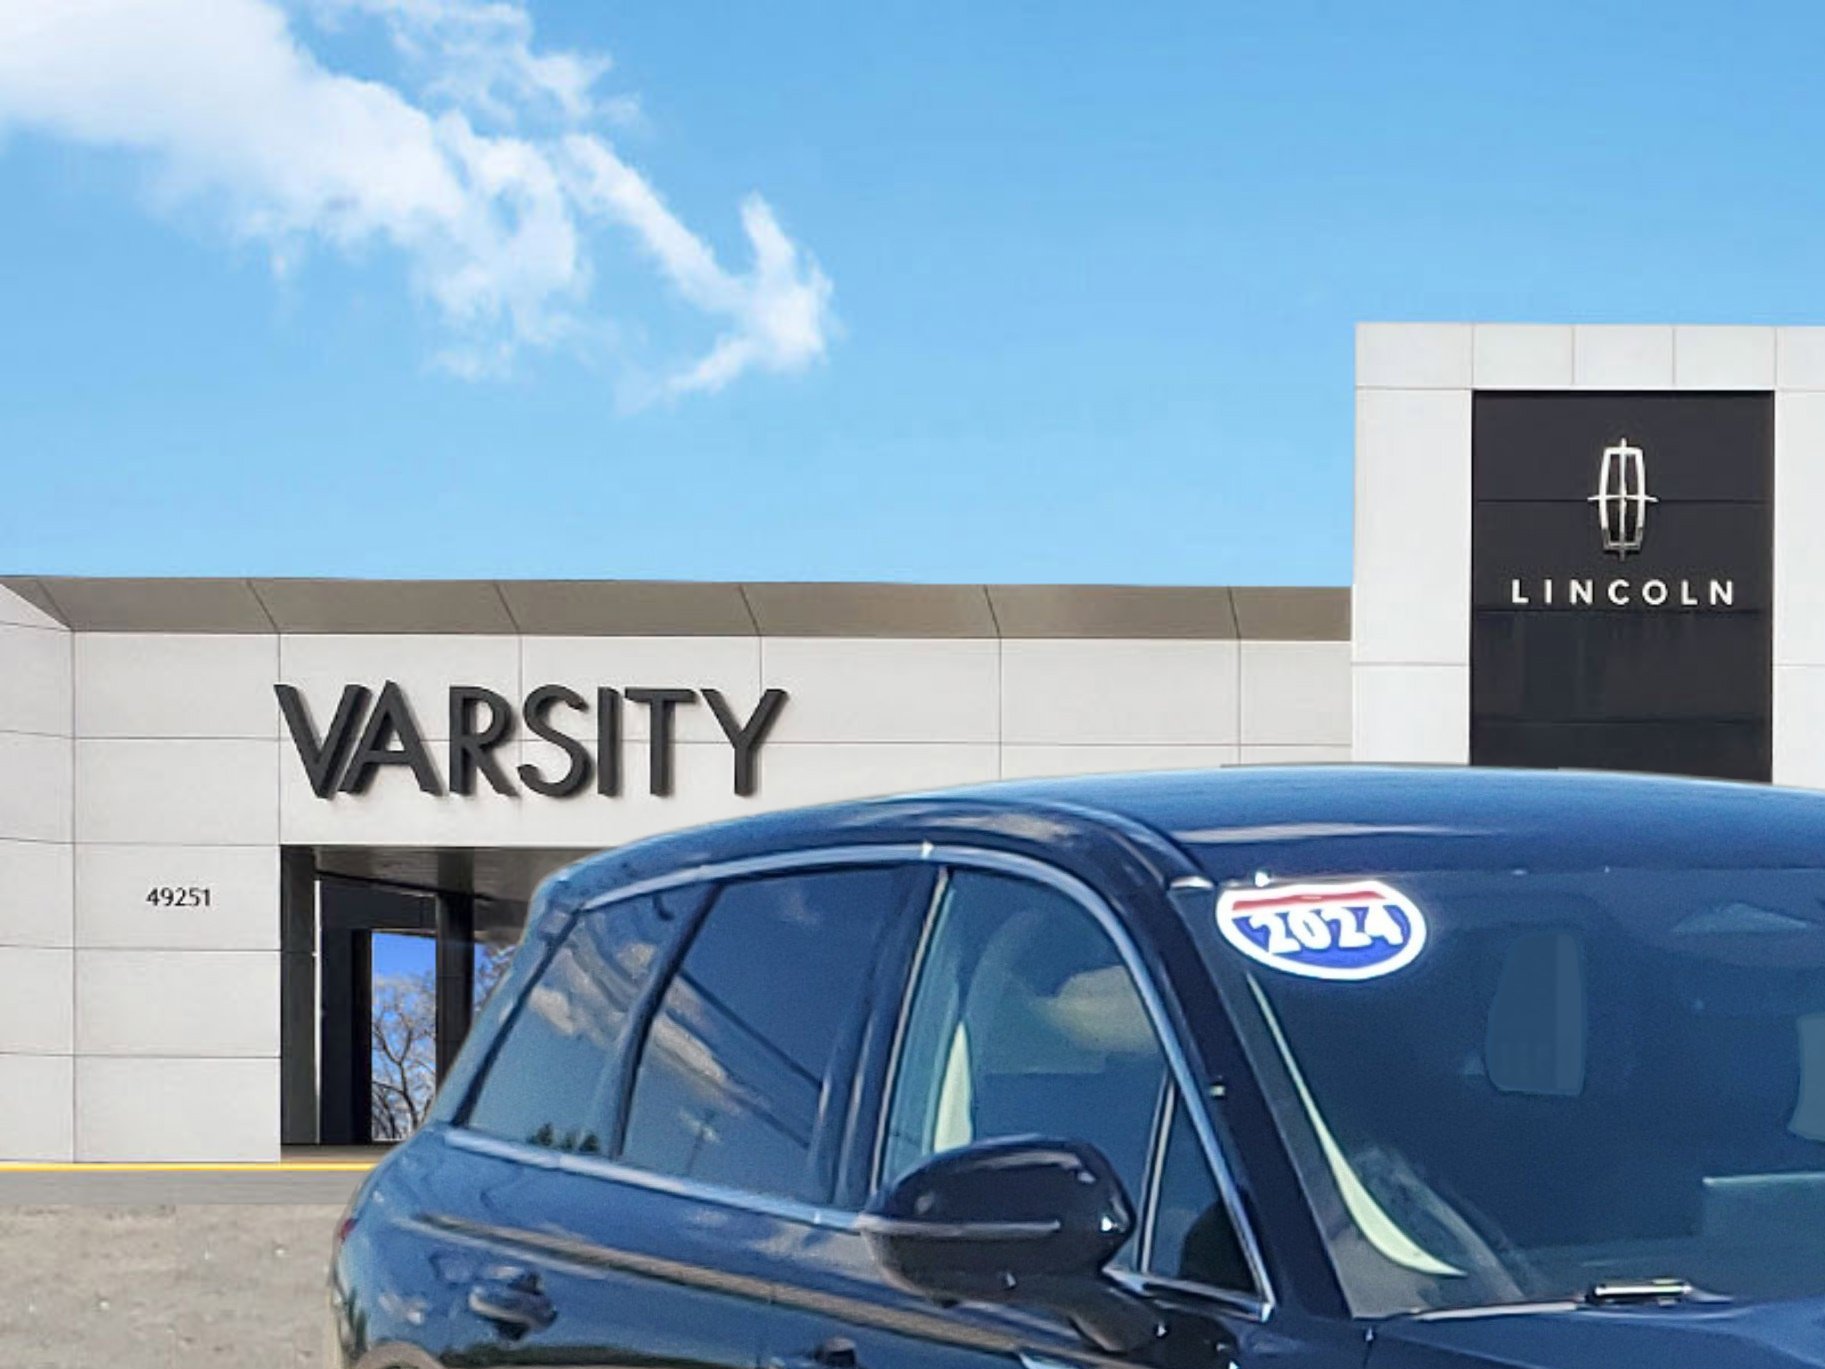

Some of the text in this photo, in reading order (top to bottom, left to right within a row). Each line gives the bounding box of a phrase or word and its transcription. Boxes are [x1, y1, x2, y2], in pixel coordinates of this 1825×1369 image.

[1511, 578, 1734, 606] LINCOLN
[274, 679, 790, 801] VARSITY
[145, 886, 211, 906] 49251
[1248, 903, 1404, 953] 2024
